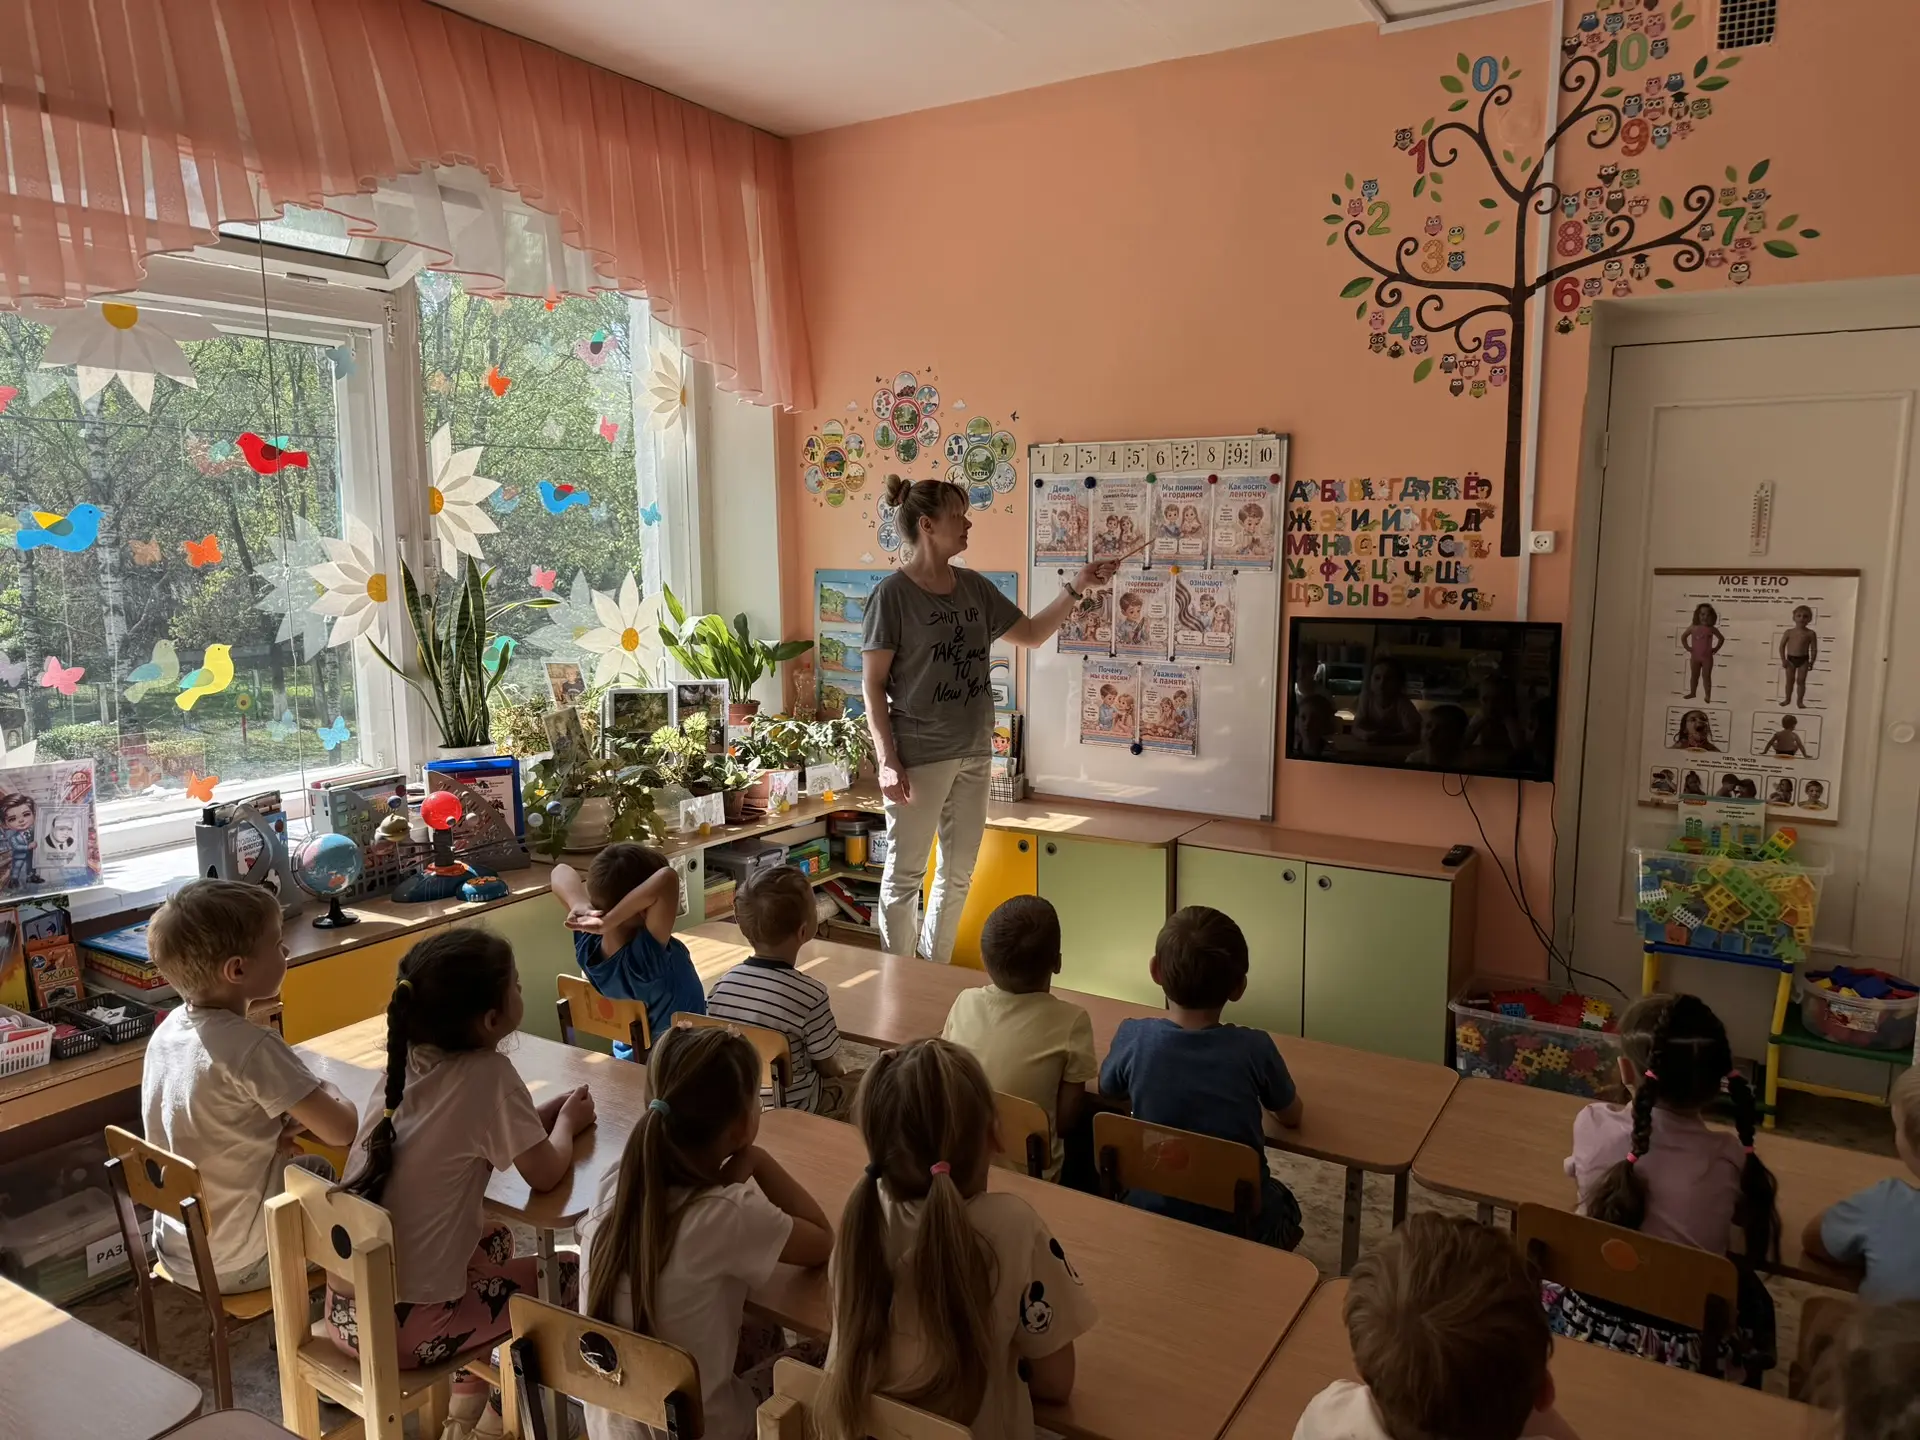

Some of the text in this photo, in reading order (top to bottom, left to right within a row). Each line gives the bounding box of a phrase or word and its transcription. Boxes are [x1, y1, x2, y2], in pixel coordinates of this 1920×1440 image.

[1598, 33, 1648, 77] 10
[1471, 55, 1498, 92] 0
[1620, 118, 1651, 157] 9
[1408, 139, 1427, 174] 1
[1367, 201, 1391, 236] 2
[1717, 206, 1746, 246] 7
[1556, 220, 1584, 258] 8
[1421, 239, 1445, 274] 3
[1554, 276, 1580, 312] 6
[1388, 306, 1414, 341] 4
[1483, 329, 1507, 364] 5
[1040, 446, 1272, 467] 1 2 3 4 5 6 7 8 9 10
[1047, 492, 1076, 502] Победы
[1052, 484, 1070, 493] День
[1161, 483, 1203, 491] Мы помним
[1169, 491, 1203, 499] гордимся
[1228, 483, 1267, 491] Как носить
[1229, 490, 1267, 499] ленточку
[1189, 579, 1223, 587] означают
[1199, 572, 1212, 580] Что
[1718, 575, 1789, 586] МОЕ ТЕЛО
[926, 607, 979, 626] SHUT UP
[953, 625, 966, 643] &
[930, 642, 964, 663] TAKE
[952, 660, 971, 681] TO
[1098, 665, 1123, 675] Почему
[1153, 669, 1187, 679] Уважение
[931, 674, 991, 707] New York
[1159, 678, 1187, 686] памяти
